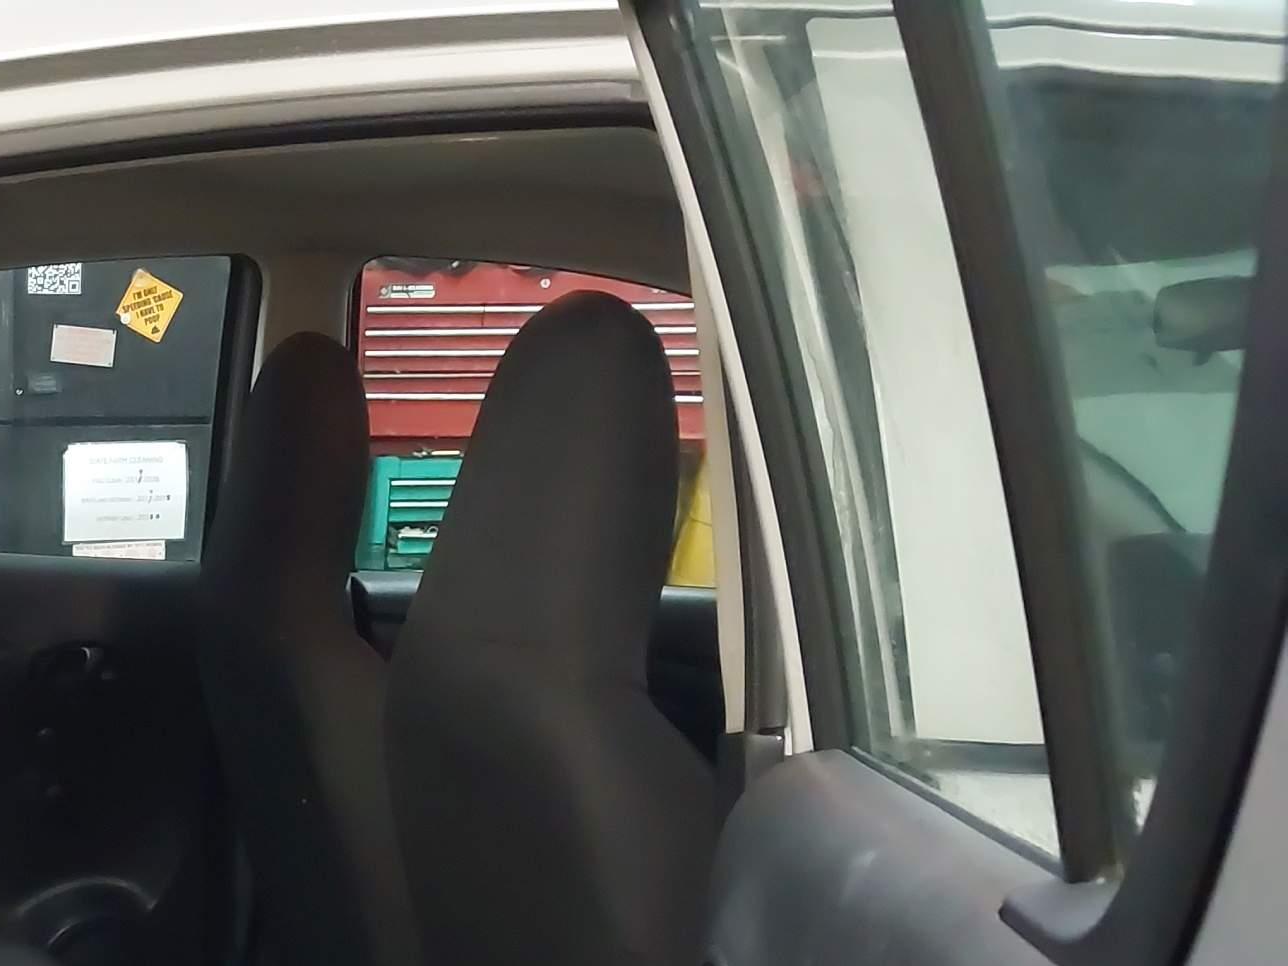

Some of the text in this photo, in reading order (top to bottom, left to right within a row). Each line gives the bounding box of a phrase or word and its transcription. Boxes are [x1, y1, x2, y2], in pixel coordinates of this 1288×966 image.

[133, 286, 158, 300] I'M ONLY
[122, 298, 152, 313] SPEEDING
[140, 306, 156, 317] HAVE
[155, 303, 164, 312] TO
[144, 314, 160, 326] POOP
